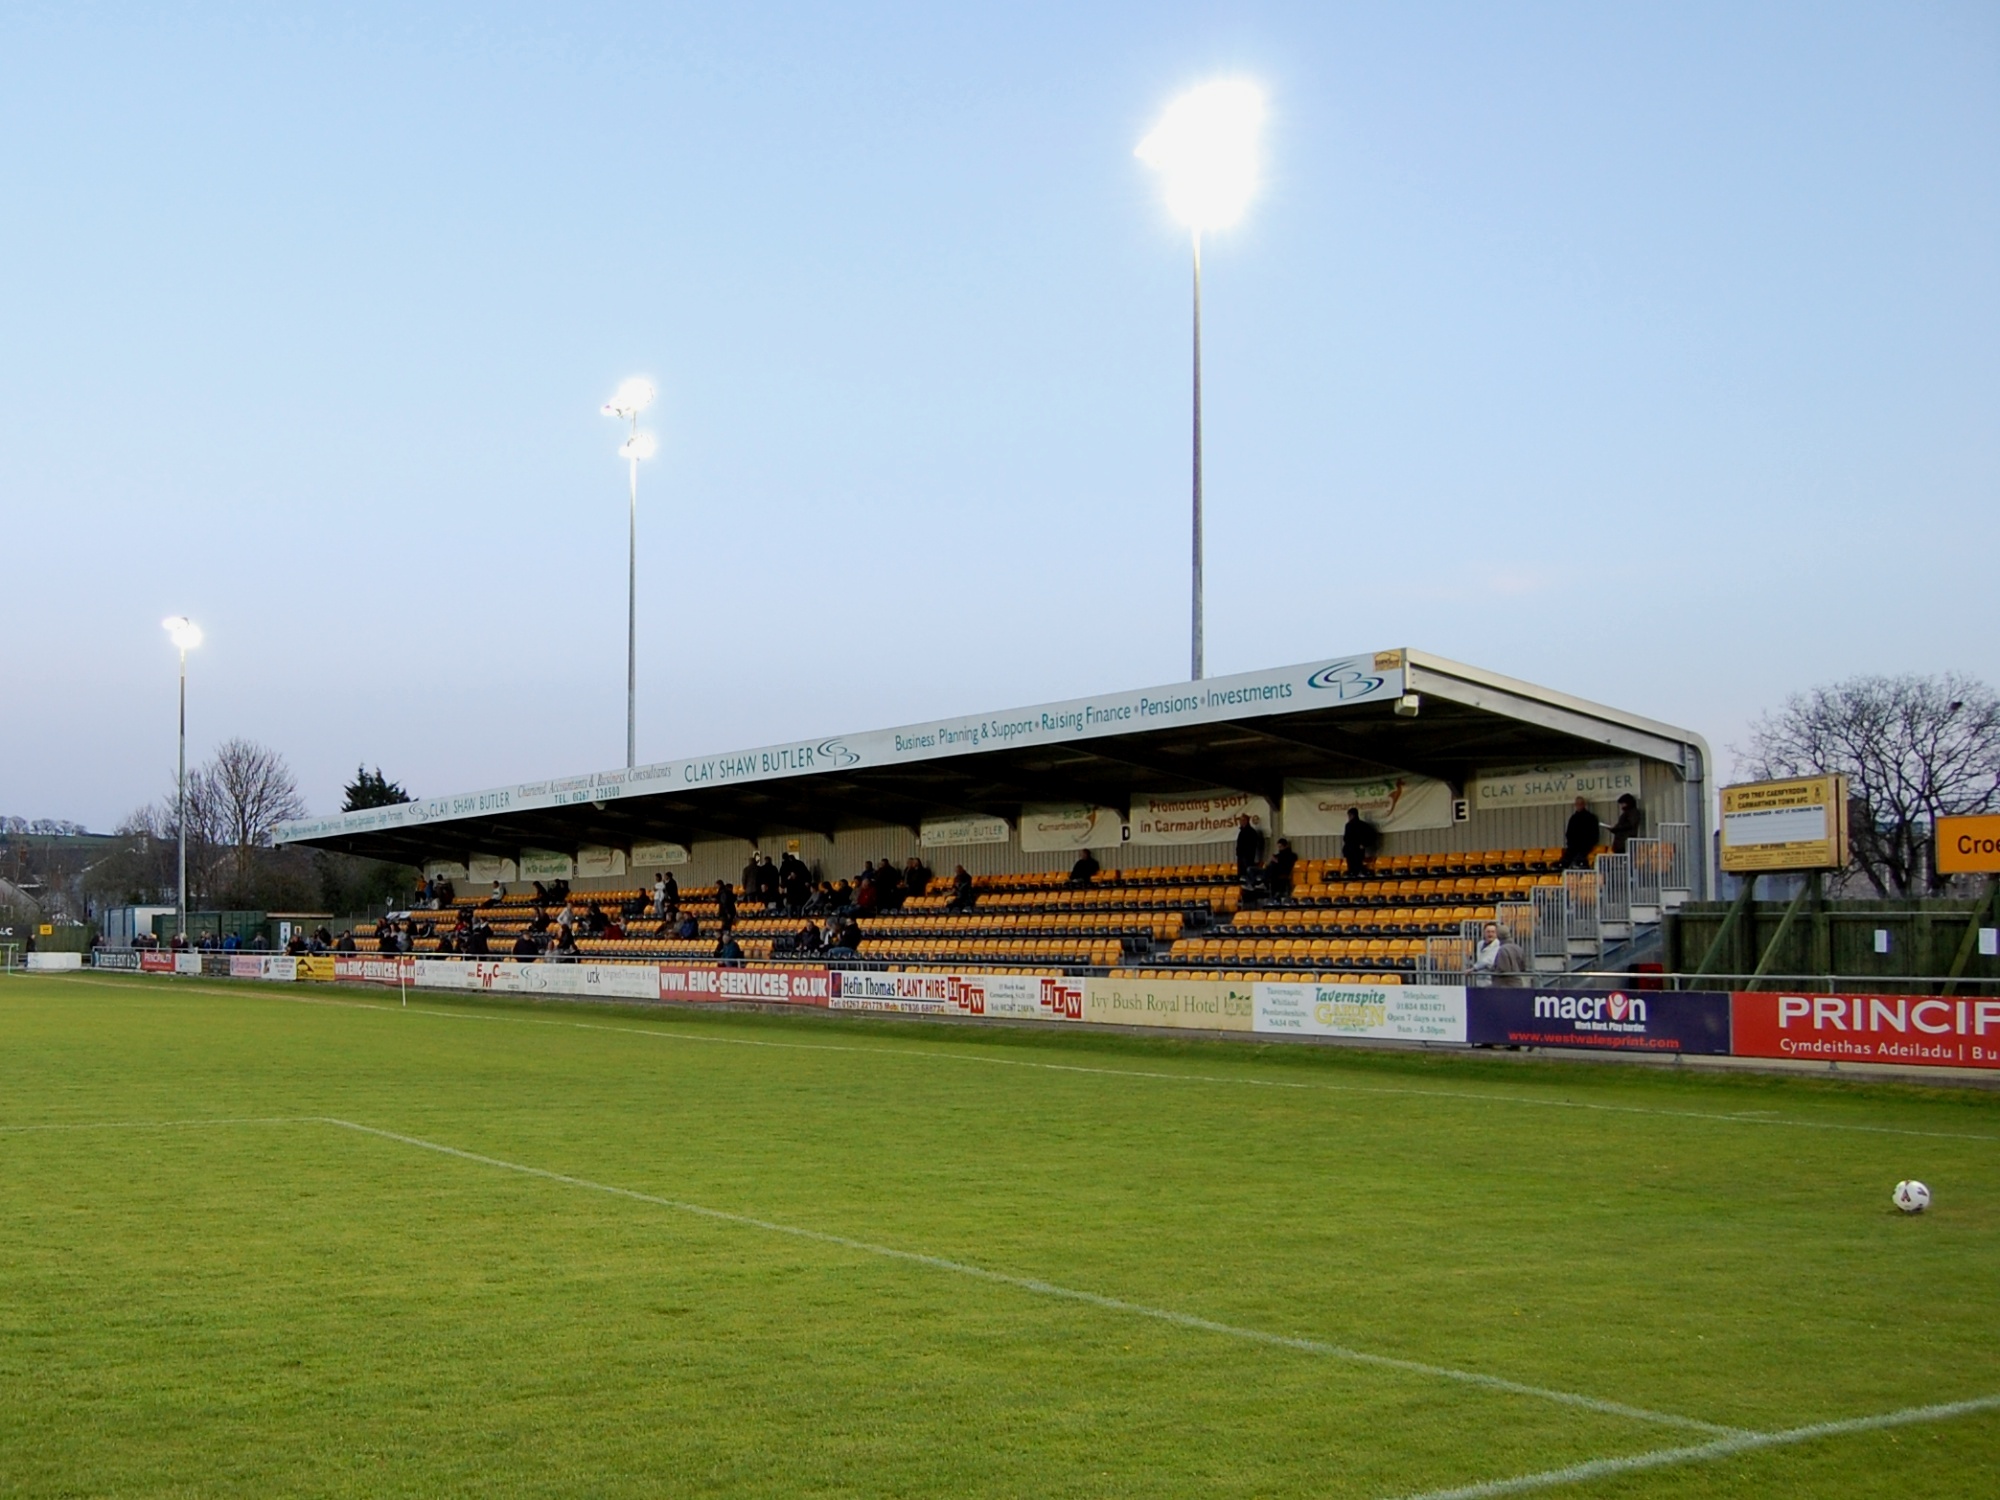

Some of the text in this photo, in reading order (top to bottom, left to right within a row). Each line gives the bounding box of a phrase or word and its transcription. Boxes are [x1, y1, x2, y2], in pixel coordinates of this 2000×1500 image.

[895, 681, 1293, 752] Business Planning & Support Raising Finance Pensions Investments
[628, 764, 672, 784] Consultants
[684, 746, 815, 783] CLAY SHAW BUTLER
[1481, 775, 1632, 798] CLAY SHAW BUTLER
[429, 791, 511, 818] CLAY SHAW BUTLER
[1149, 793, 1249, 813] Promoting sport
[1455, 801, 1467, 820] E
[974, 825, 1003, 837] BUTLER
[1122, 825, 1130, 841] D
[1140, 814, 1260, 833] in Carmarthenshre
[843, 976, 863, 995] Hefin
[865, 977, 896, 996] Thomas
[897, 978, 923, 998] PLANT
[925, 979, 946, 999] HIRE
[1315, 987, 1386, 1006] Tavernspite
[1091, 991, 1109, 1014] Ivy
[1112, 992, 1142, 1011] Bush
[1147, 993, 1179, 1017] Royal
[1184, 995, 1219, 1013] Hotel
[1534, 992, 1646, 1022] macron
[1778, 997, 2000, 1035] PRINCIP
[1508, 1033, 1680, 1048] www.westwalesprint.com
[1780, 1038, 1871, 1055] Cymdeithas
[1878, 1042, 1952, 1058] Adeiladu
